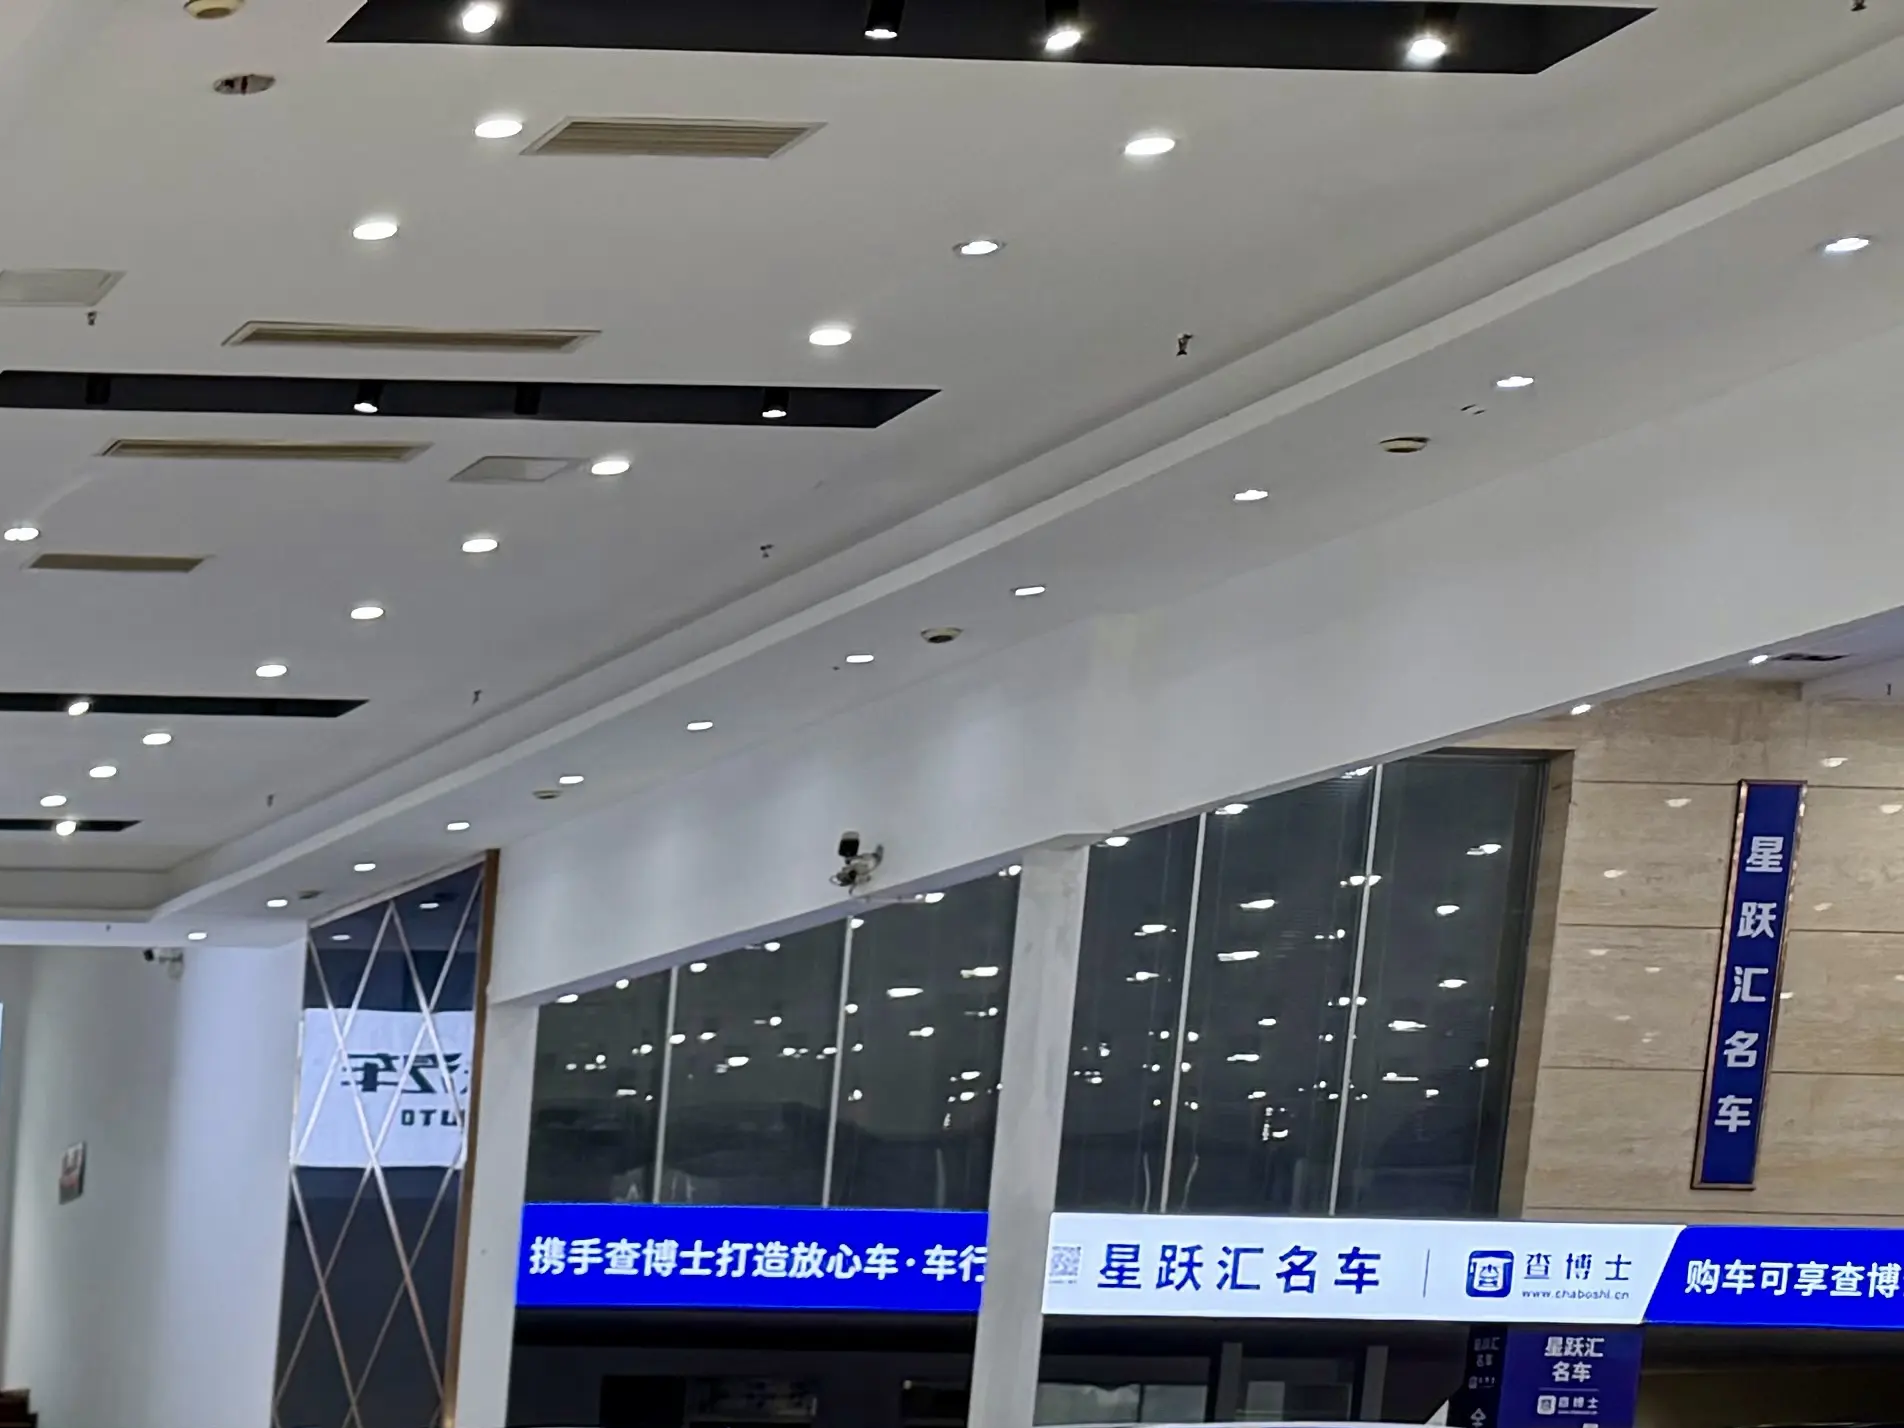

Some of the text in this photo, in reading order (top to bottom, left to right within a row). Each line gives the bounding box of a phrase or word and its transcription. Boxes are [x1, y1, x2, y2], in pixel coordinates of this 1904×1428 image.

[1714, 836, 1784, 1132] 星跃汇名车
[1097, 1243, 1381, 1294] 星跃汇名车
[1524, 1252, 1632, 1281] 查博士
[1684, 1258, 1904, 1299] 购车可享查博
[1544, 1336, 1605, 1357] 星跃汇
[1552, 1361, 1592, 1383] 名车
